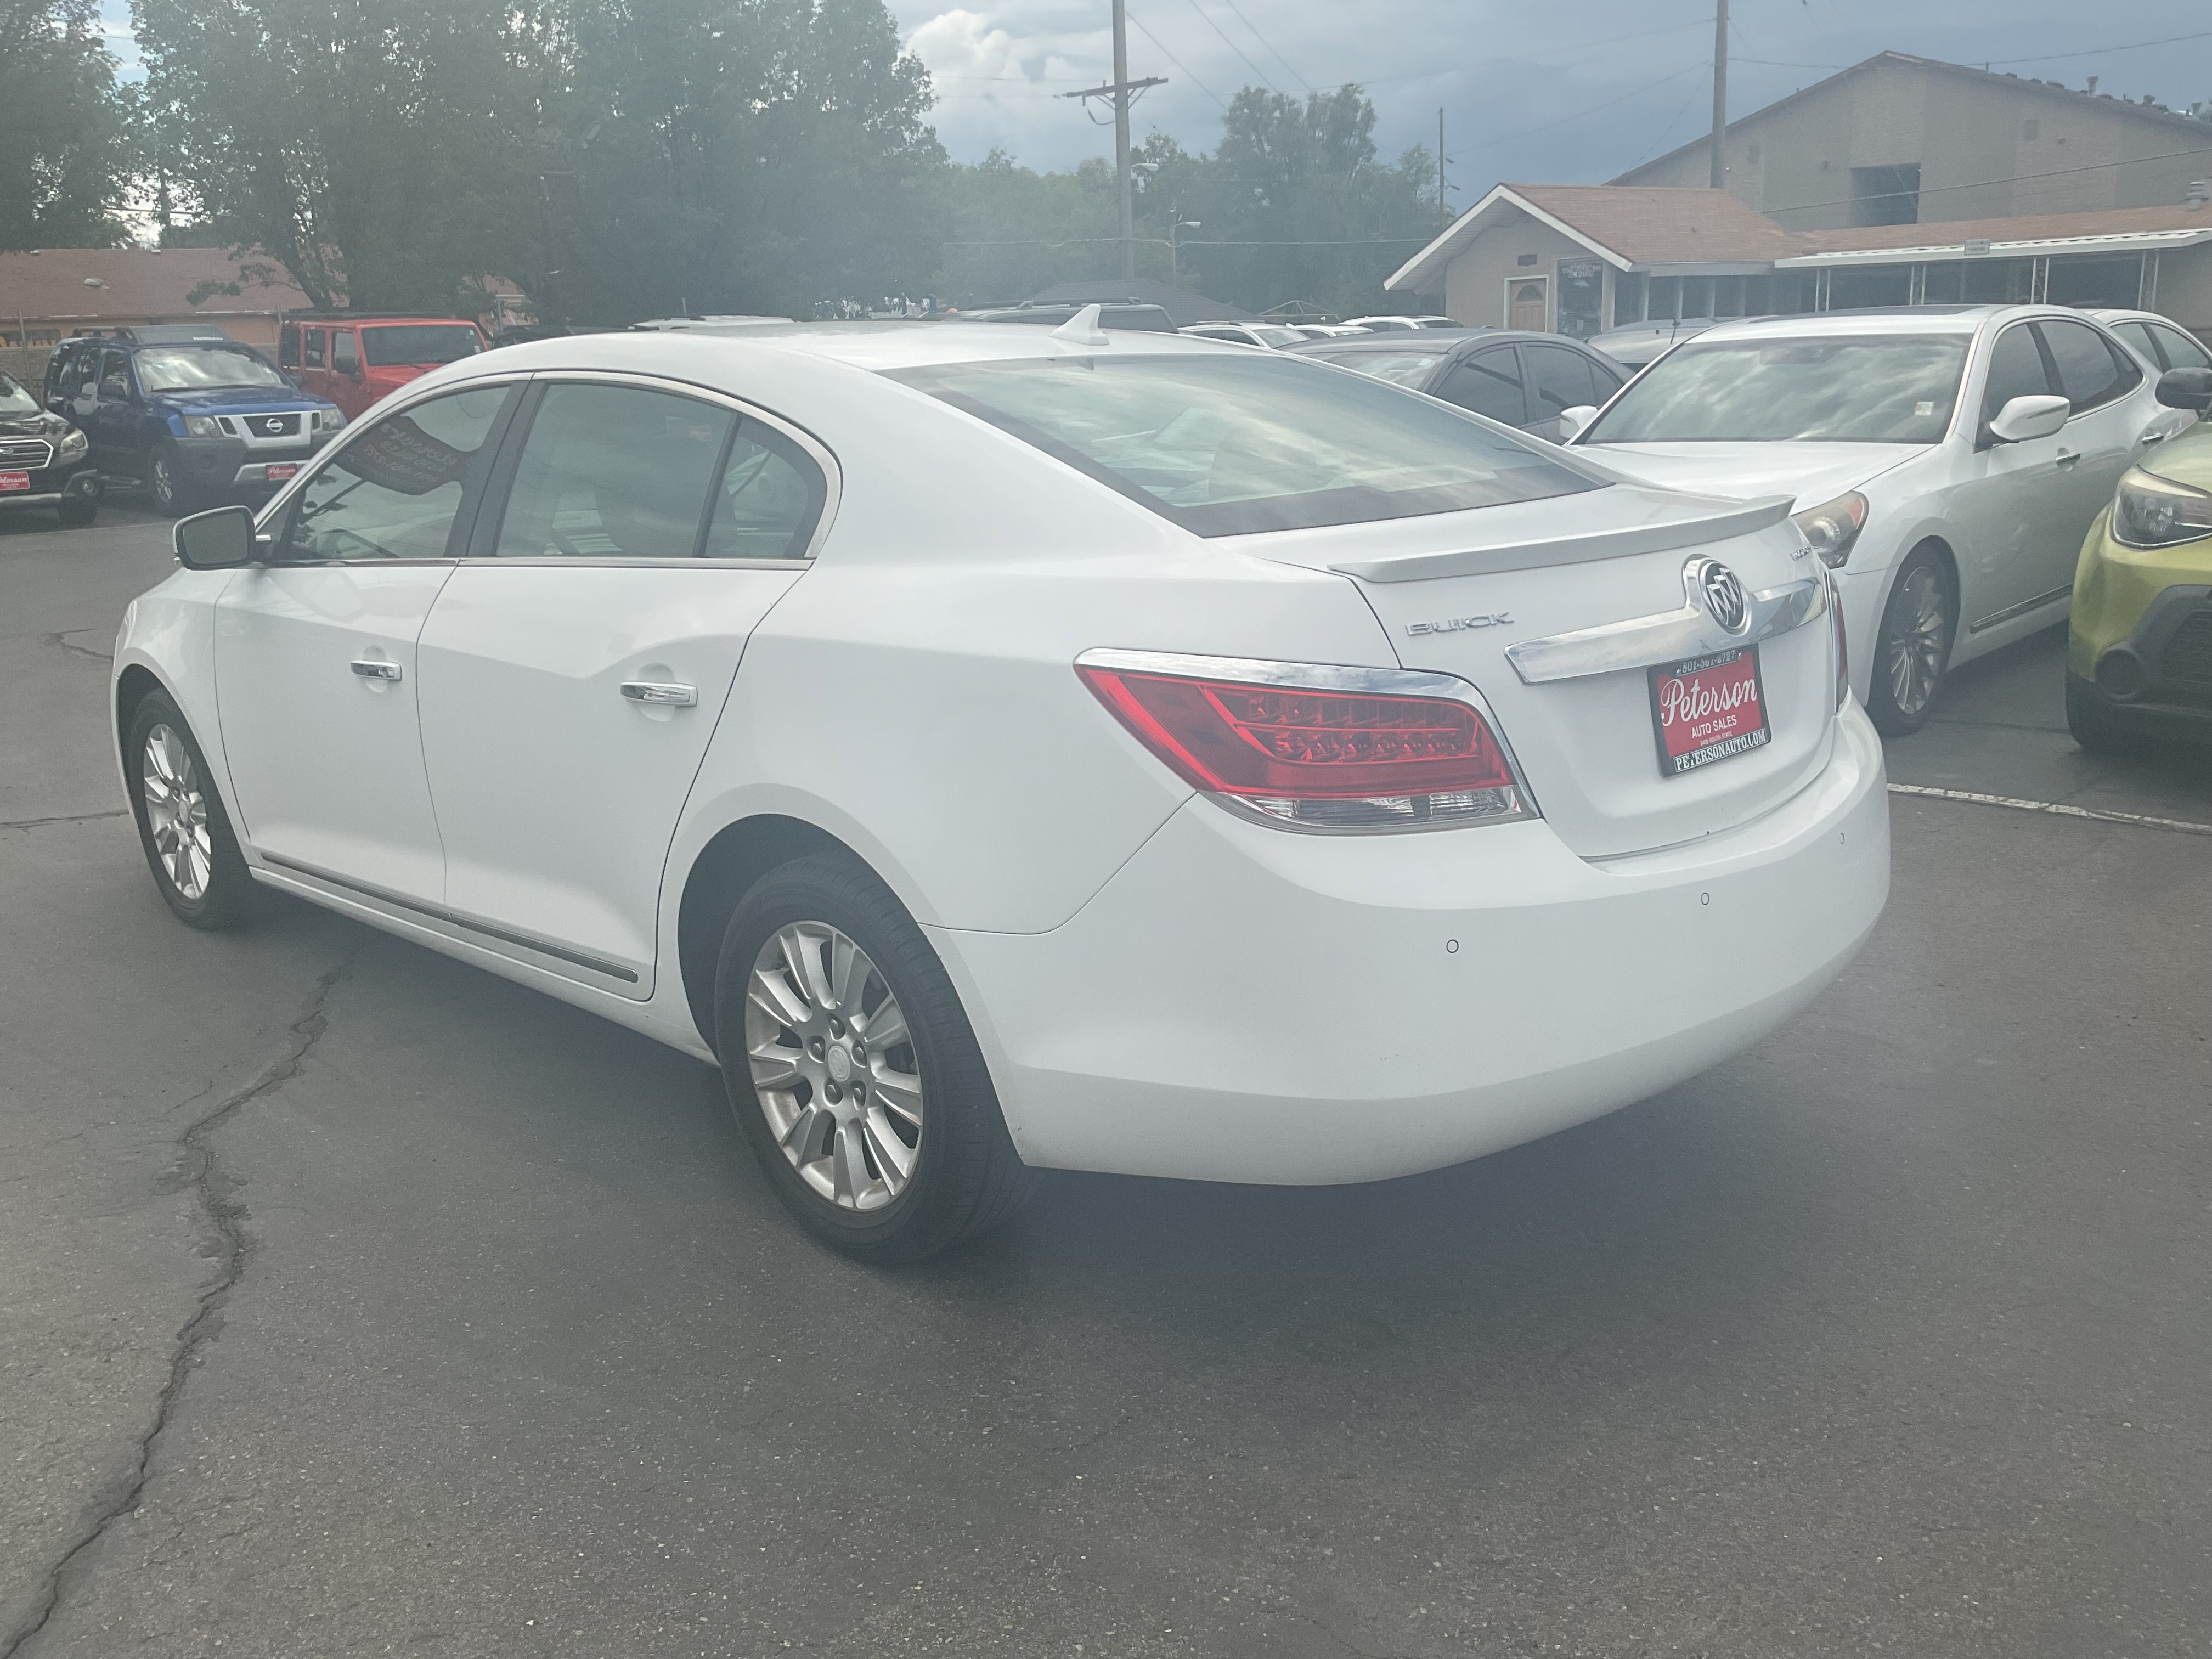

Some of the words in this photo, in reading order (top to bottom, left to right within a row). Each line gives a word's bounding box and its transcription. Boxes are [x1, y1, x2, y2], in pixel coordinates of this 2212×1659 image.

[1405, 612, 1515, 636] BUICK
[1661, 679, 1757, 726] Peterson
[1692, 723, 1711, 739] AUTO
[1713, 714, 1737, 731] SALES
[1675, 730, 1766, 770] PETERSONAUTO.COM
